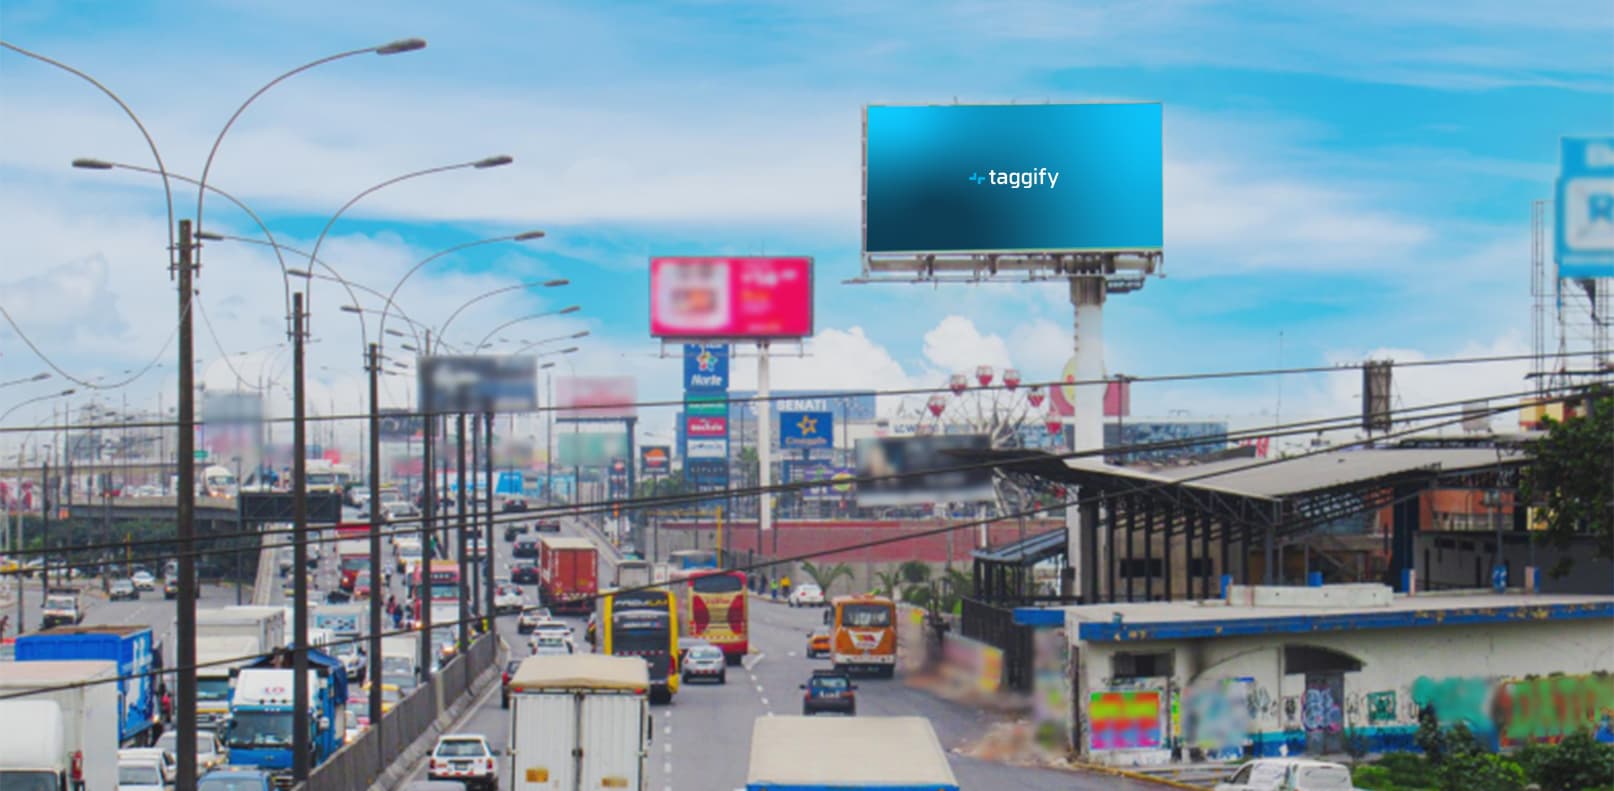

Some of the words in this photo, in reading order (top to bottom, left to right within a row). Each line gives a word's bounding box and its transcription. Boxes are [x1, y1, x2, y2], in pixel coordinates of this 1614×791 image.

[988, 167, 1060, 189] taggify
[691, 373, 723, 387] Norte
[776, 398, 827, 411] SENATI
